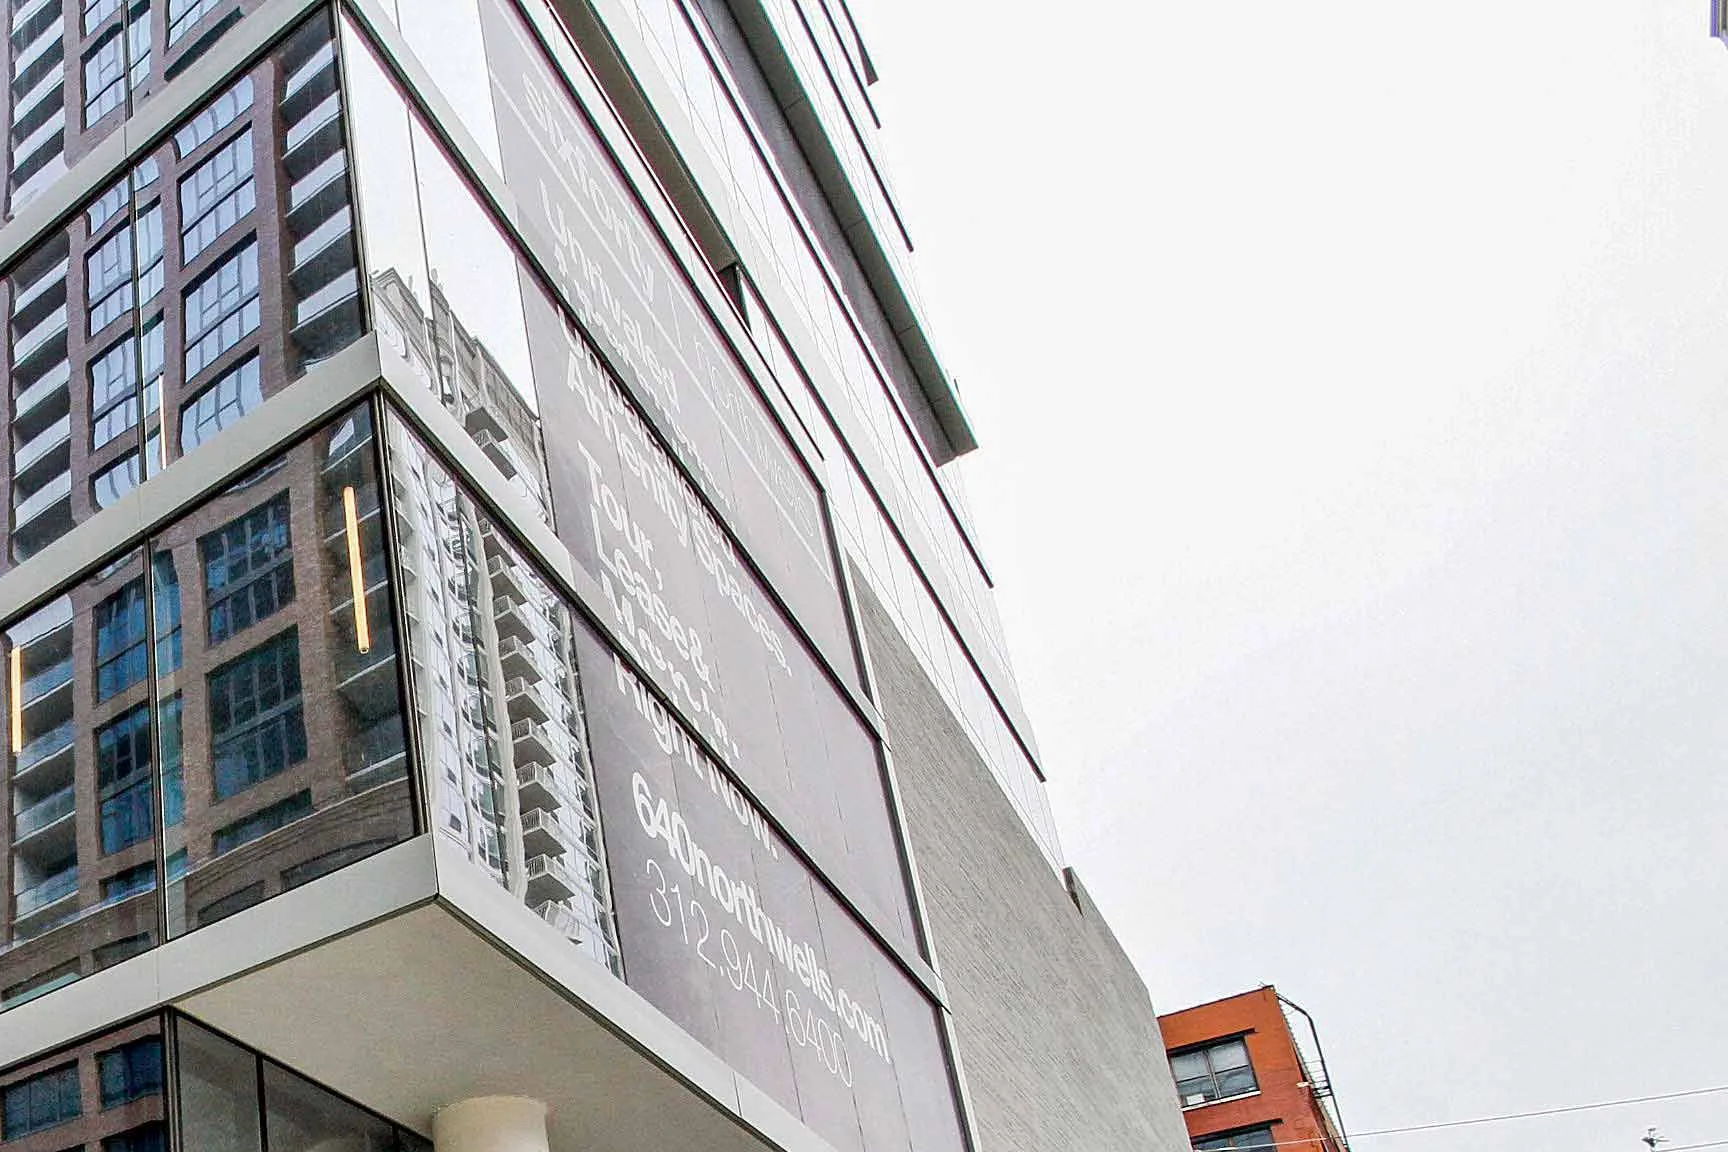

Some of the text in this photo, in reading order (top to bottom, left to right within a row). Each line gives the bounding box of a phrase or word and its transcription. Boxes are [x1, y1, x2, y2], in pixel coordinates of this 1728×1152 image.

[522, 71, 656, 304] sixforty
[539, 178, 680, 414] Unrivaled
[568, 352, 792, 677] Amenity Spaces.
[577, 440, 663, 591] Tour,
[590, 503, 715, 693] Lease&
[613, 631, 704, 780] Right
[632, 771, 891, 1064] 640northwells.com
[646, 858, 852, 1088] 312.944.6400
